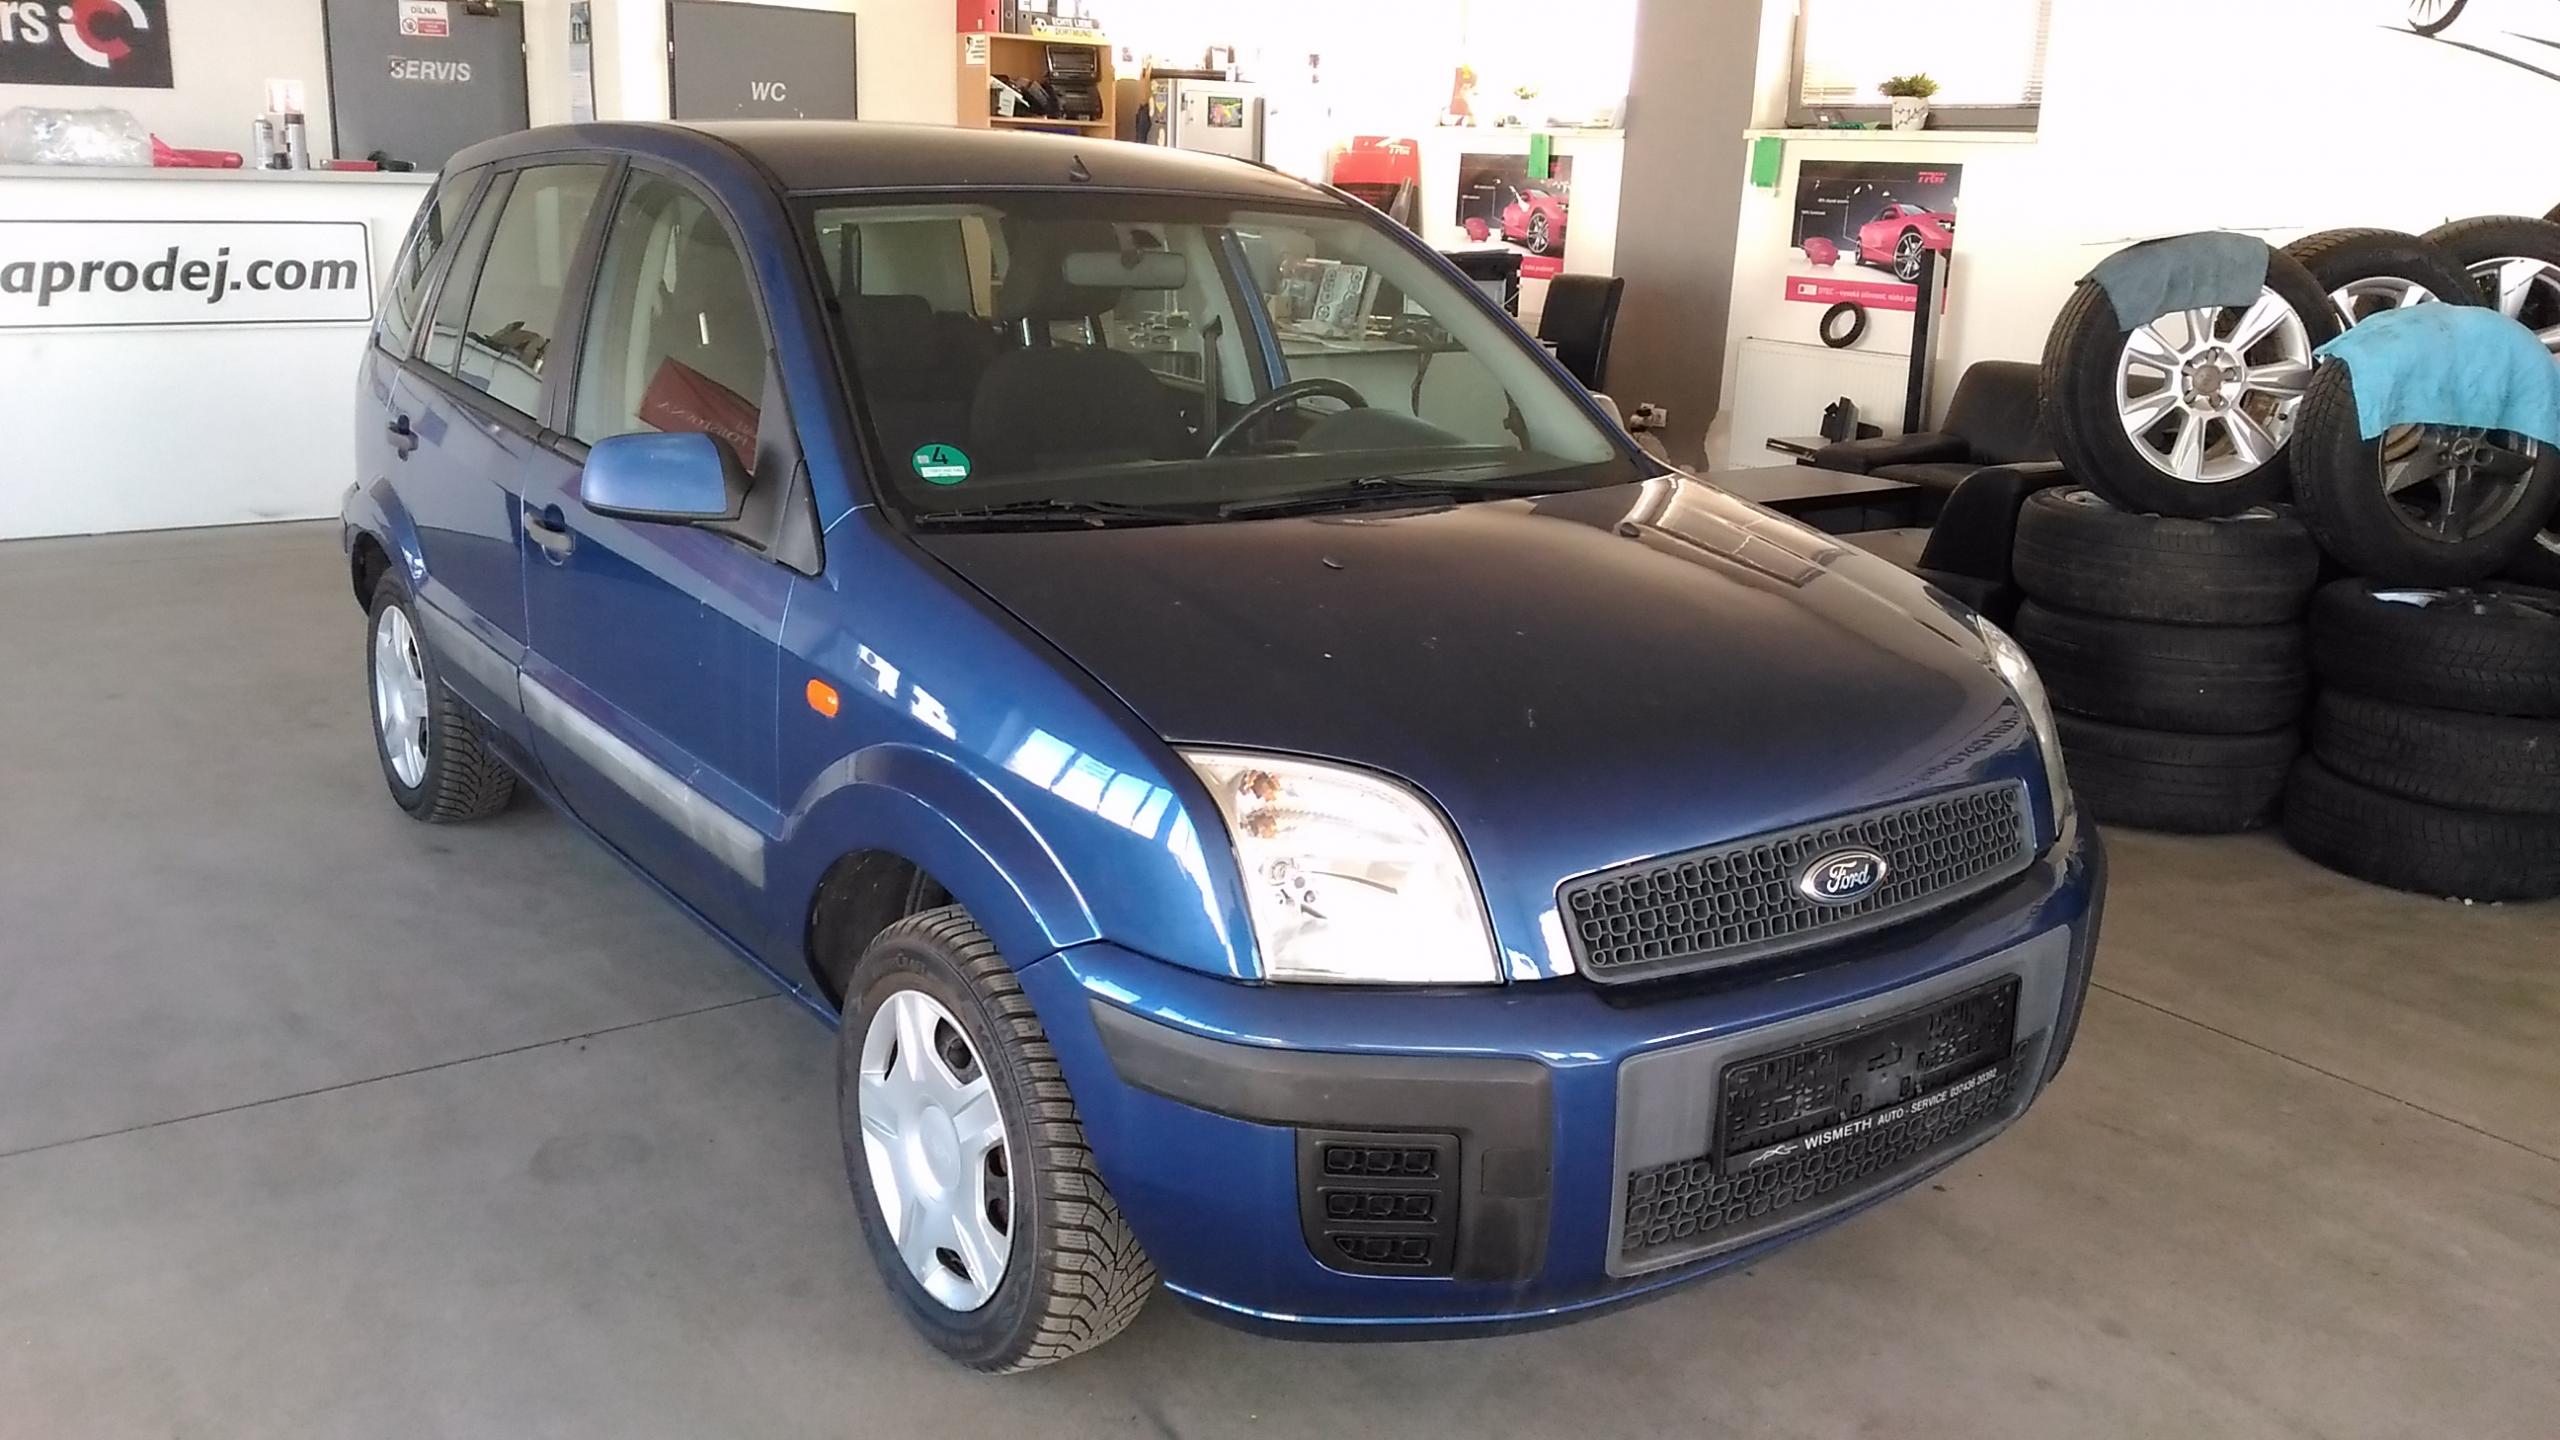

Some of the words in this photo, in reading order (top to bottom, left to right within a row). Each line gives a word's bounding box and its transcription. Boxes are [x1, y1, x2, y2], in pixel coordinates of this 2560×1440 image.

[390, 60, 471, 81] SERVIS
[751, 81, 787, 102] WC
[0, 245, 358, 307] aprodej.com
[932, 446, 949, 465] 4
[1826, 860, 1871, 893] Ford
[1804, 1117, 1873, 1150] WISMETH
